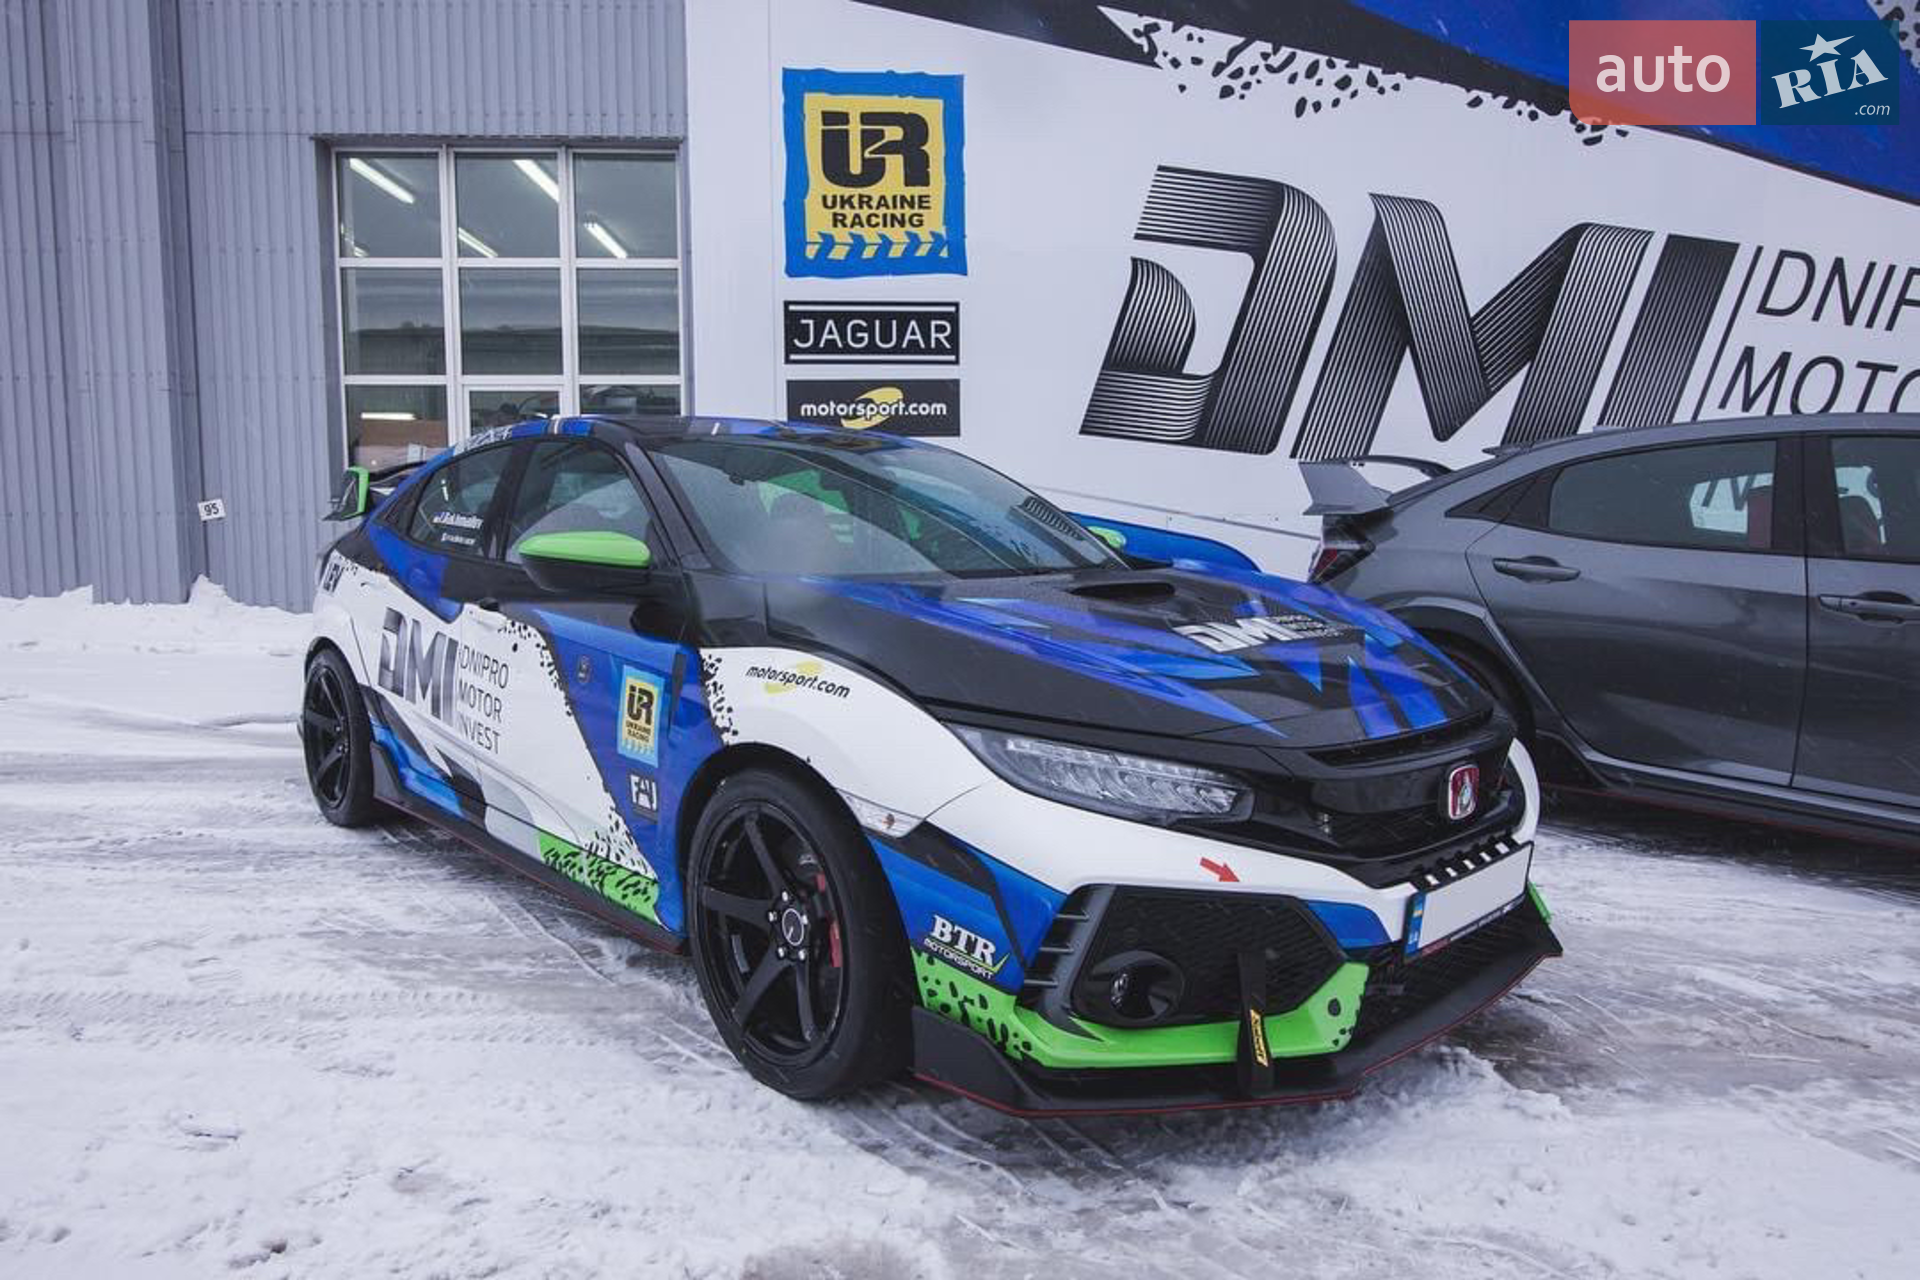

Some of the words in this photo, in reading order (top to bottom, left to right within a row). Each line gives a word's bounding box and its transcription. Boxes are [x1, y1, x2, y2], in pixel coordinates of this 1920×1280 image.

[821, 194, 931, 211] UKRAINE
[831, 212, 925, 229] RACING
[1079, 165, 1740, 459] DMI
[793, 318, 952, 350] JAGUAR
[800, 400, 947, 421] motorsport.com
[203, 502, 220, 516] 95
[460, 644, 509, 689] DNIPRO
[745, 665, 851, 698] motorsport.com
[459, 678, 503, 723] MOTOR
[931, 914, 996, 967] BTR
